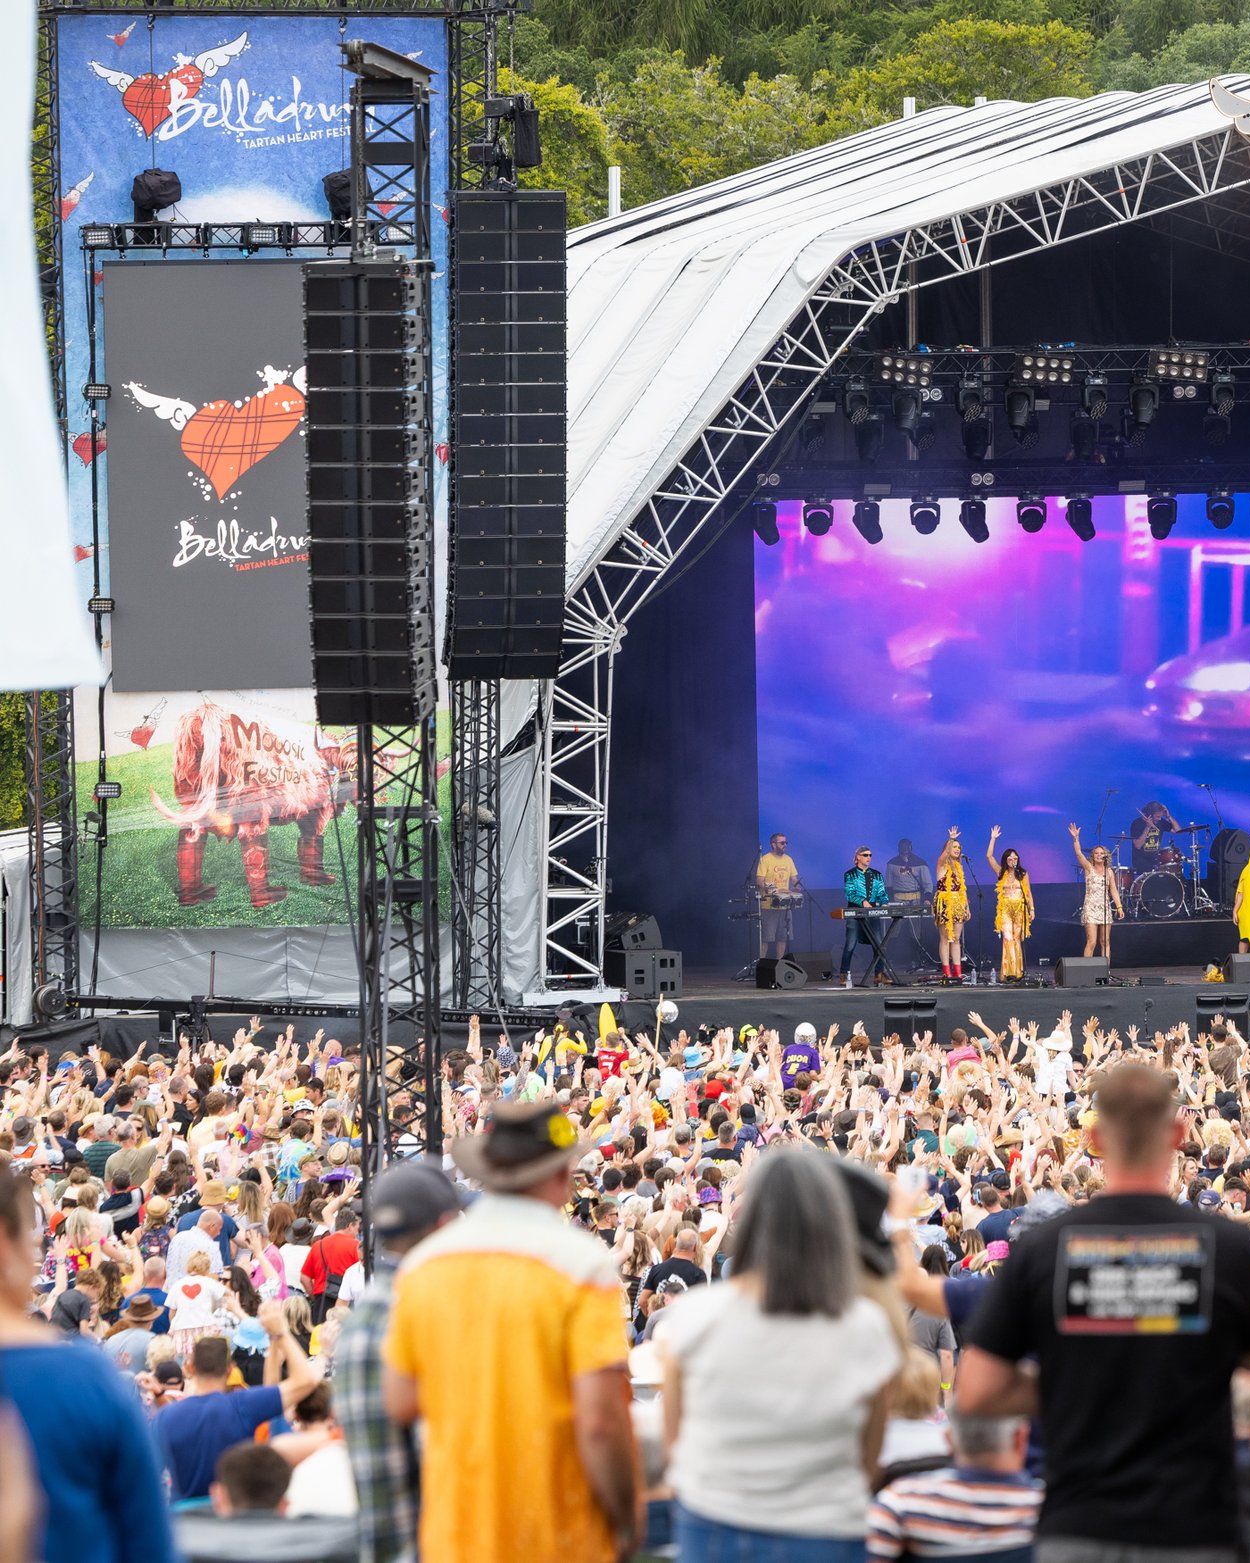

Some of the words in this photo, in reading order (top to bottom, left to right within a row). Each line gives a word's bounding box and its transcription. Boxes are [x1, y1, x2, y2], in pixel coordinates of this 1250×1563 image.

[243, 135, 286, 149] TARTAN
[287, 130, 324, 144] HEART
[326, 123, 377, 138] FESTL
[172, 516, 312, 567] Belladru
[235, 562, 266, 572] TARTAN
[267, 555, 295, 567] HEART
